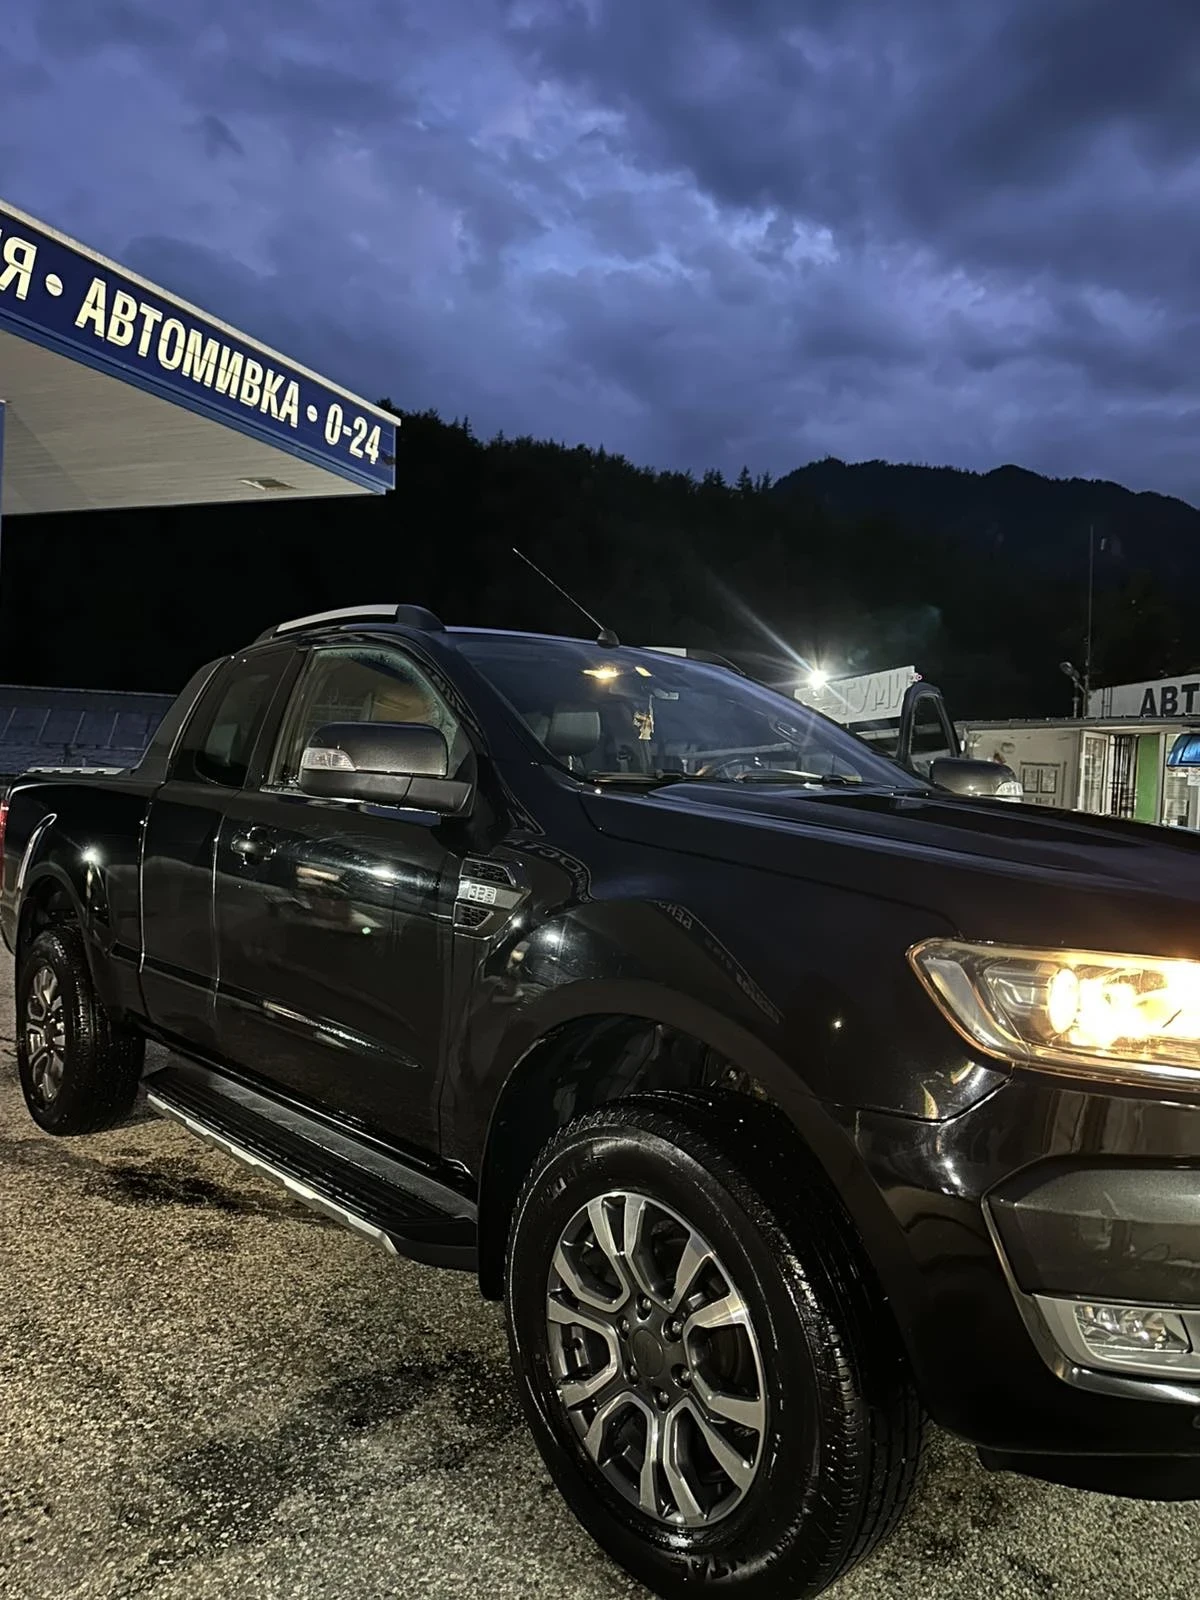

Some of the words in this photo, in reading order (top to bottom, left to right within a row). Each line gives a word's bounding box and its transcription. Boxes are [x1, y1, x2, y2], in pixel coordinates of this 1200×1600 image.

[0, 229, 37, 301] Я
[74, 276, 300, 429] АВТОМИВКА
[323, 403, 382, 465] 0-24
